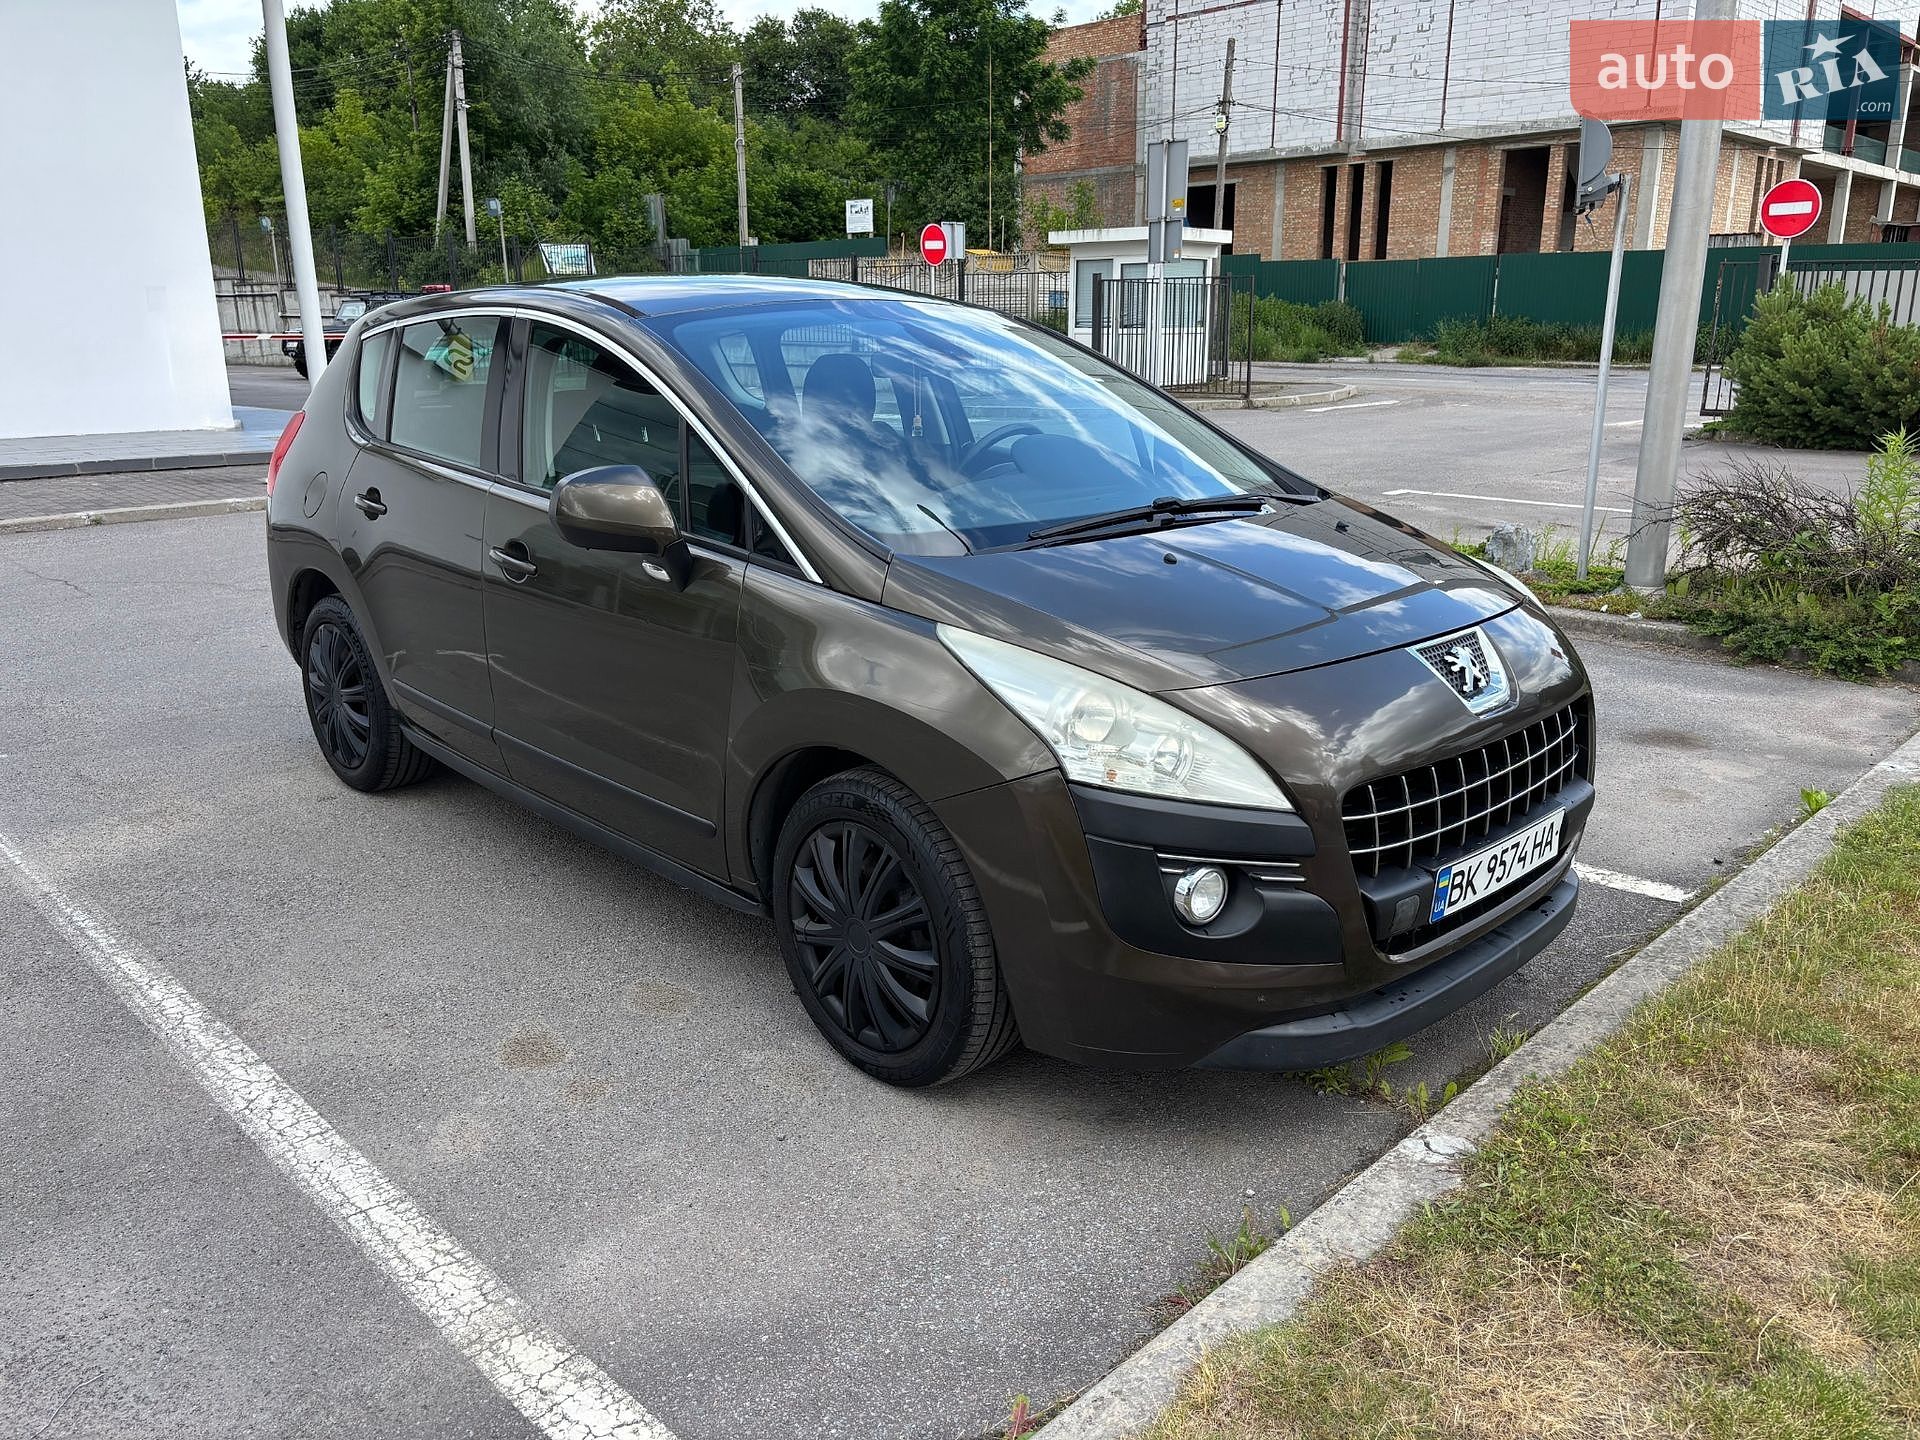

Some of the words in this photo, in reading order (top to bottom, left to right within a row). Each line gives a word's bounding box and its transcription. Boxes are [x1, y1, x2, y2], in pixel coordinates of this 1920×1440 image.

[1447, 860, 1482, 908] BK
[1483, 836, 1531, 890] 9574
[1529, 821, 1555, 864] HA
[1434, 899, 1445, 913] UA
